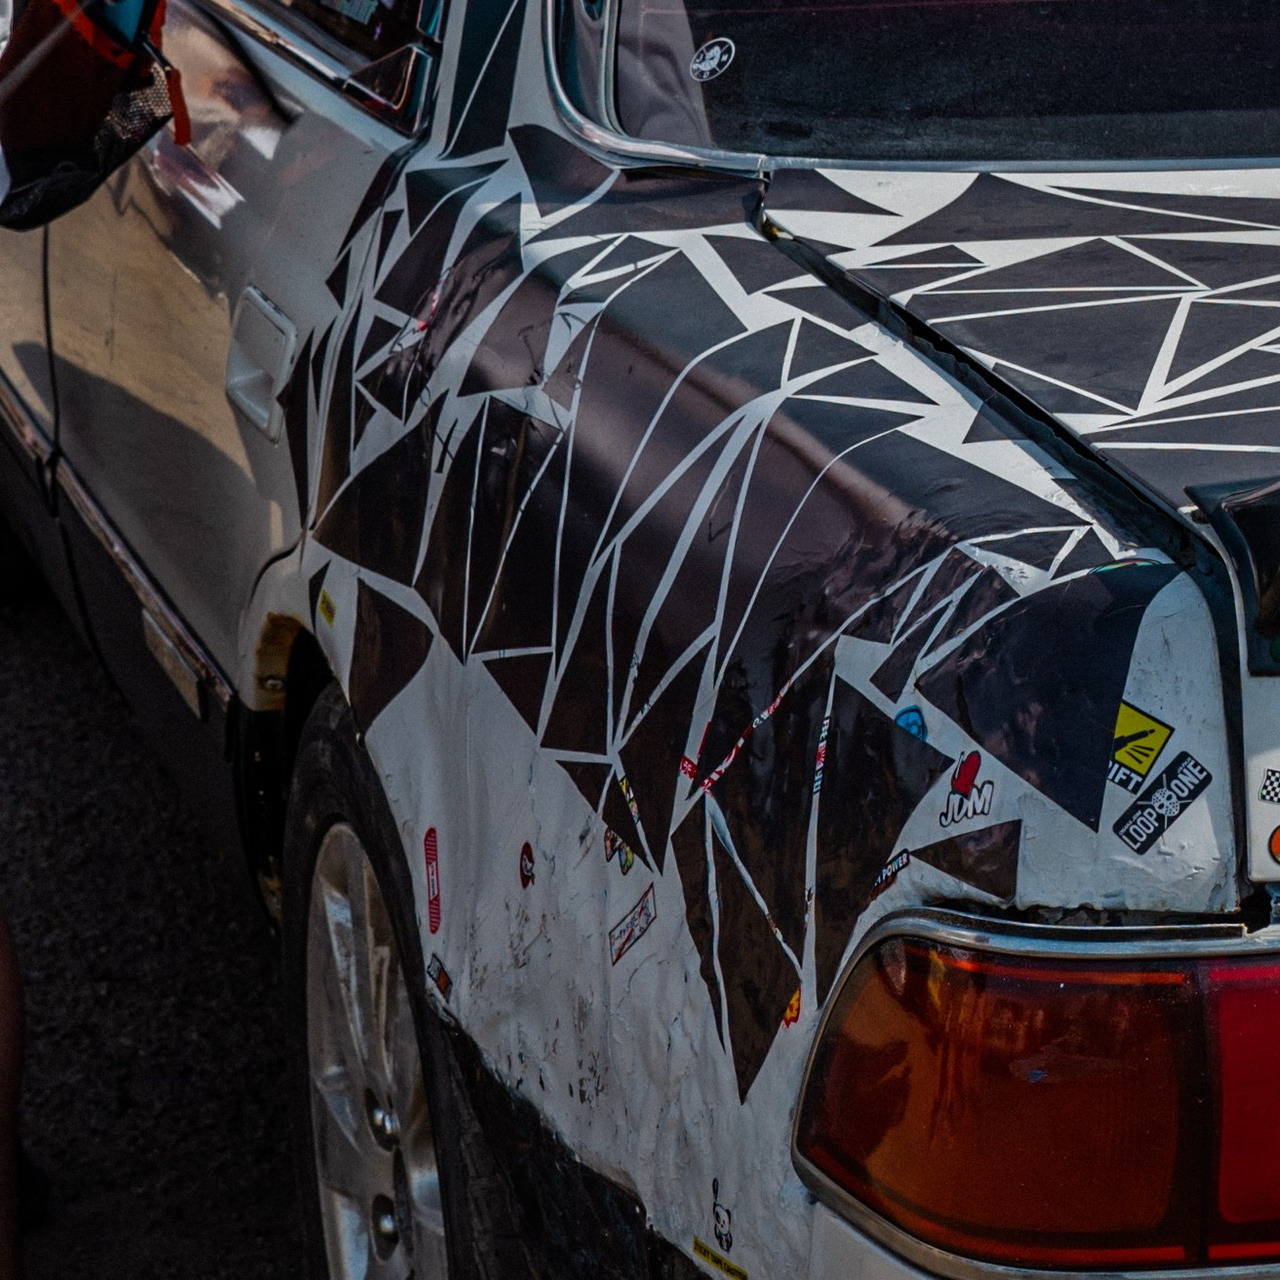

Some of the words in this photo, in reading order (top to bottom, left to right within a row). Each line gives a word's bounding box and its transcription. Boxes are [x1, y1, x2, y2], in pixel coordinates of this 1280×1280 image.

[1108, 760, 1143, 793] IFT
[940, 781, 994, 827] JDM
[1122, 810, 1158, 850] LOOP
[1170, 760, 1208, 799] ONE
